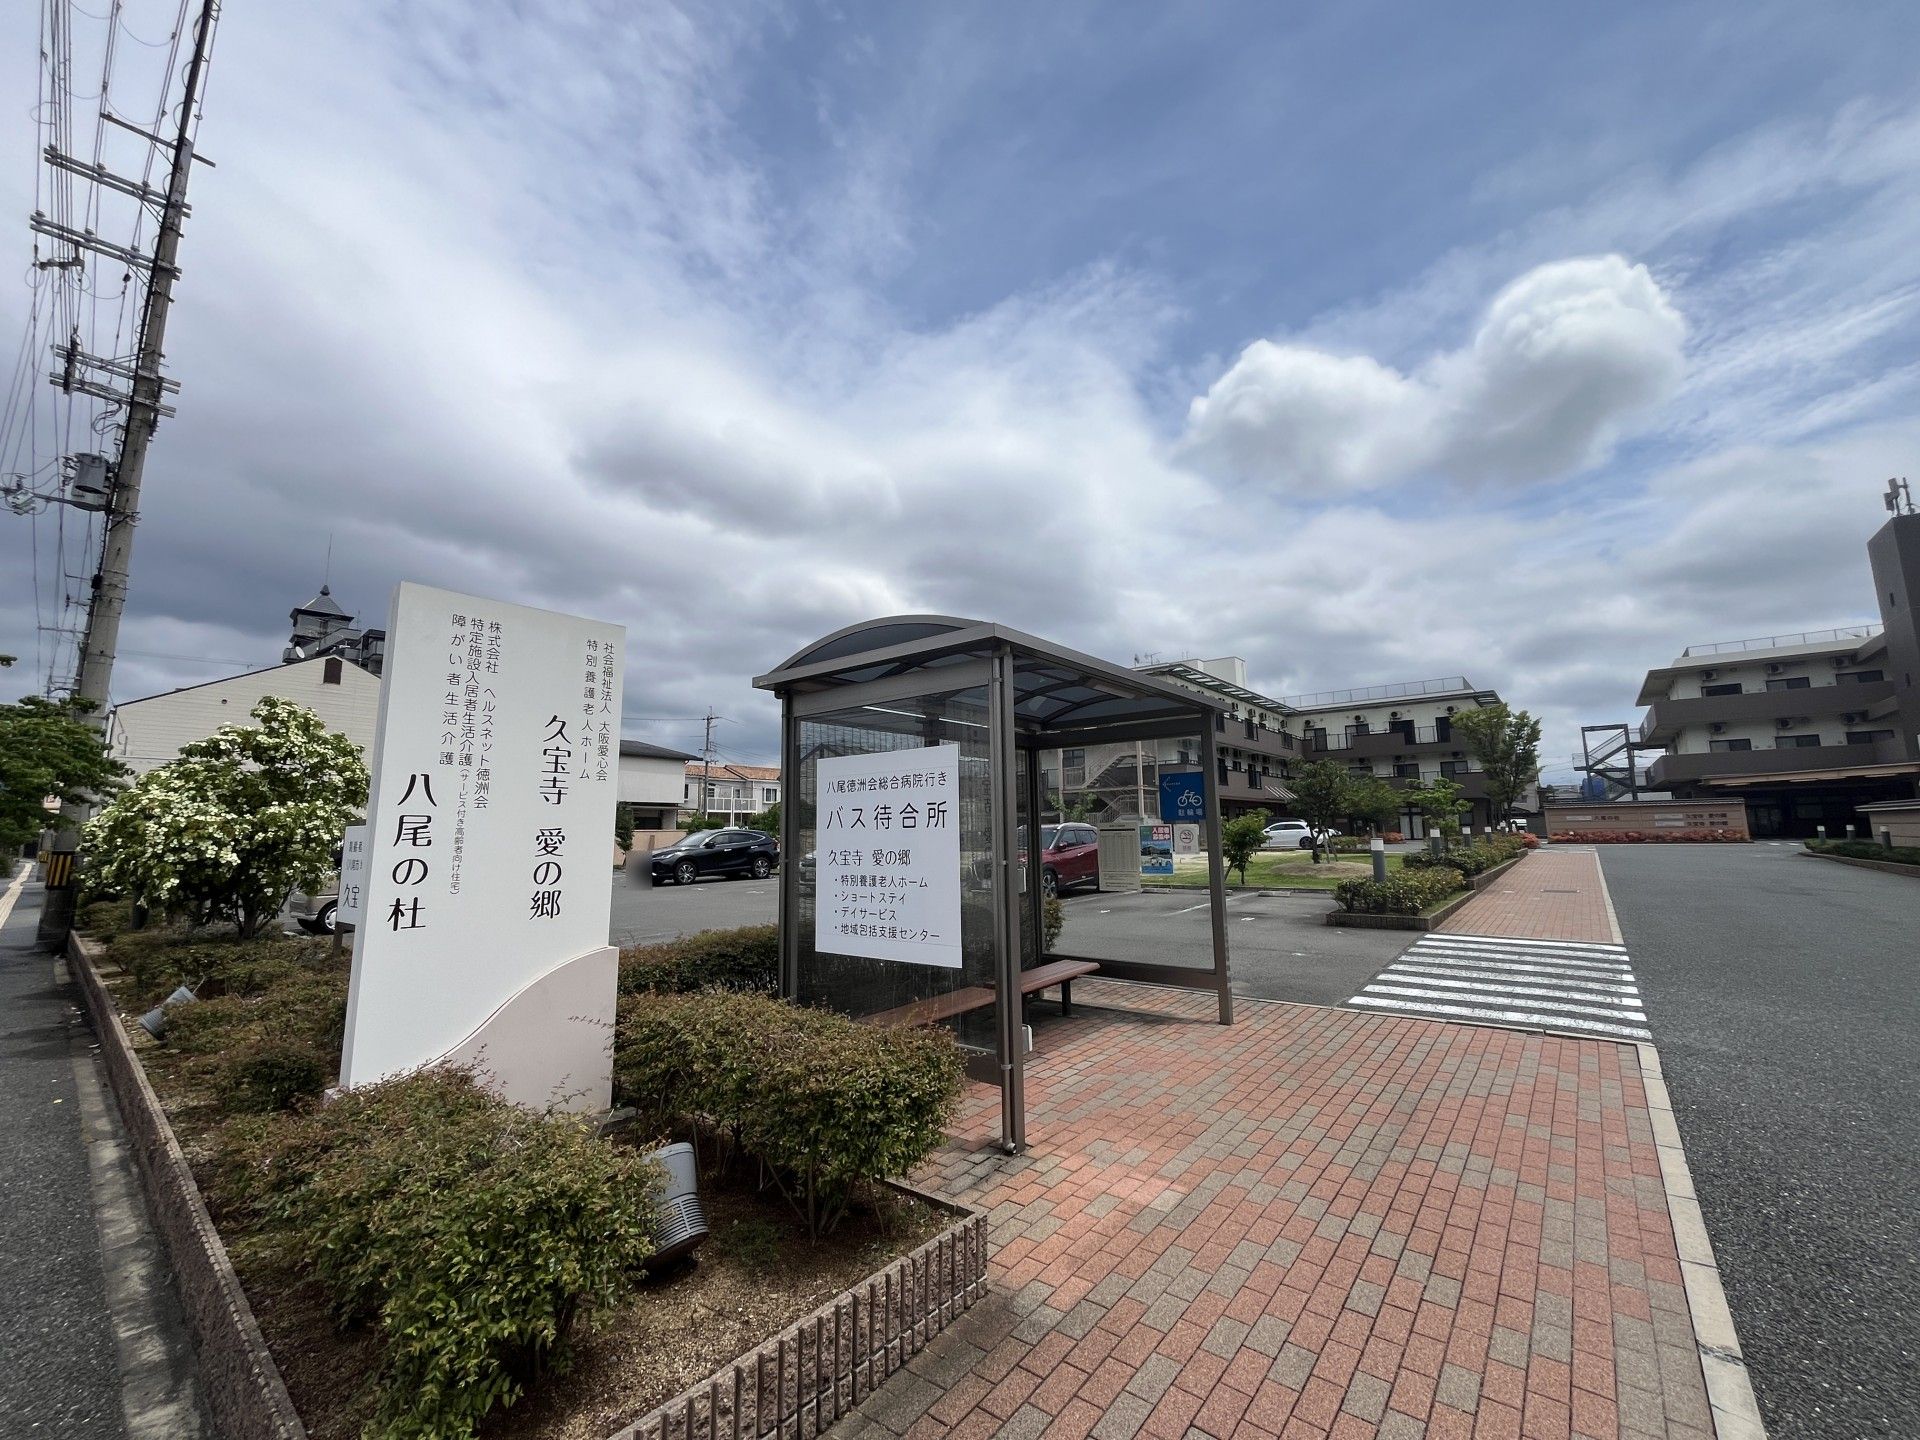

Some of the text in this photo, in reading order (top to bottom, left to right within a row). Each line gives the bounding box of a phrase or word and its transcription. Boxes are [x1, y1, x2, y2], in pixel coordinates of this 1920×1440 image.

[439, 613, 467, 766] 障がい者生活介護
[474, 620, 502, 809] 株式会社 ヘルスネット徳洲会
[579, 639, 598, 780] 特別養護老人ホーム
[596, 642, 615, 782] 社会福祉法人 大阪愛心会
[387, 773, 438, 932] 八尾の杜
[529, 715, 572, 921] 久宝寺 愛の郷
[826, 771, 948, 794] 八尾徳洲会総合病院行き
[826, 800, 948, 830] バス待合所
[828, 849, 911, 867] 久宝寺 愛の郷
